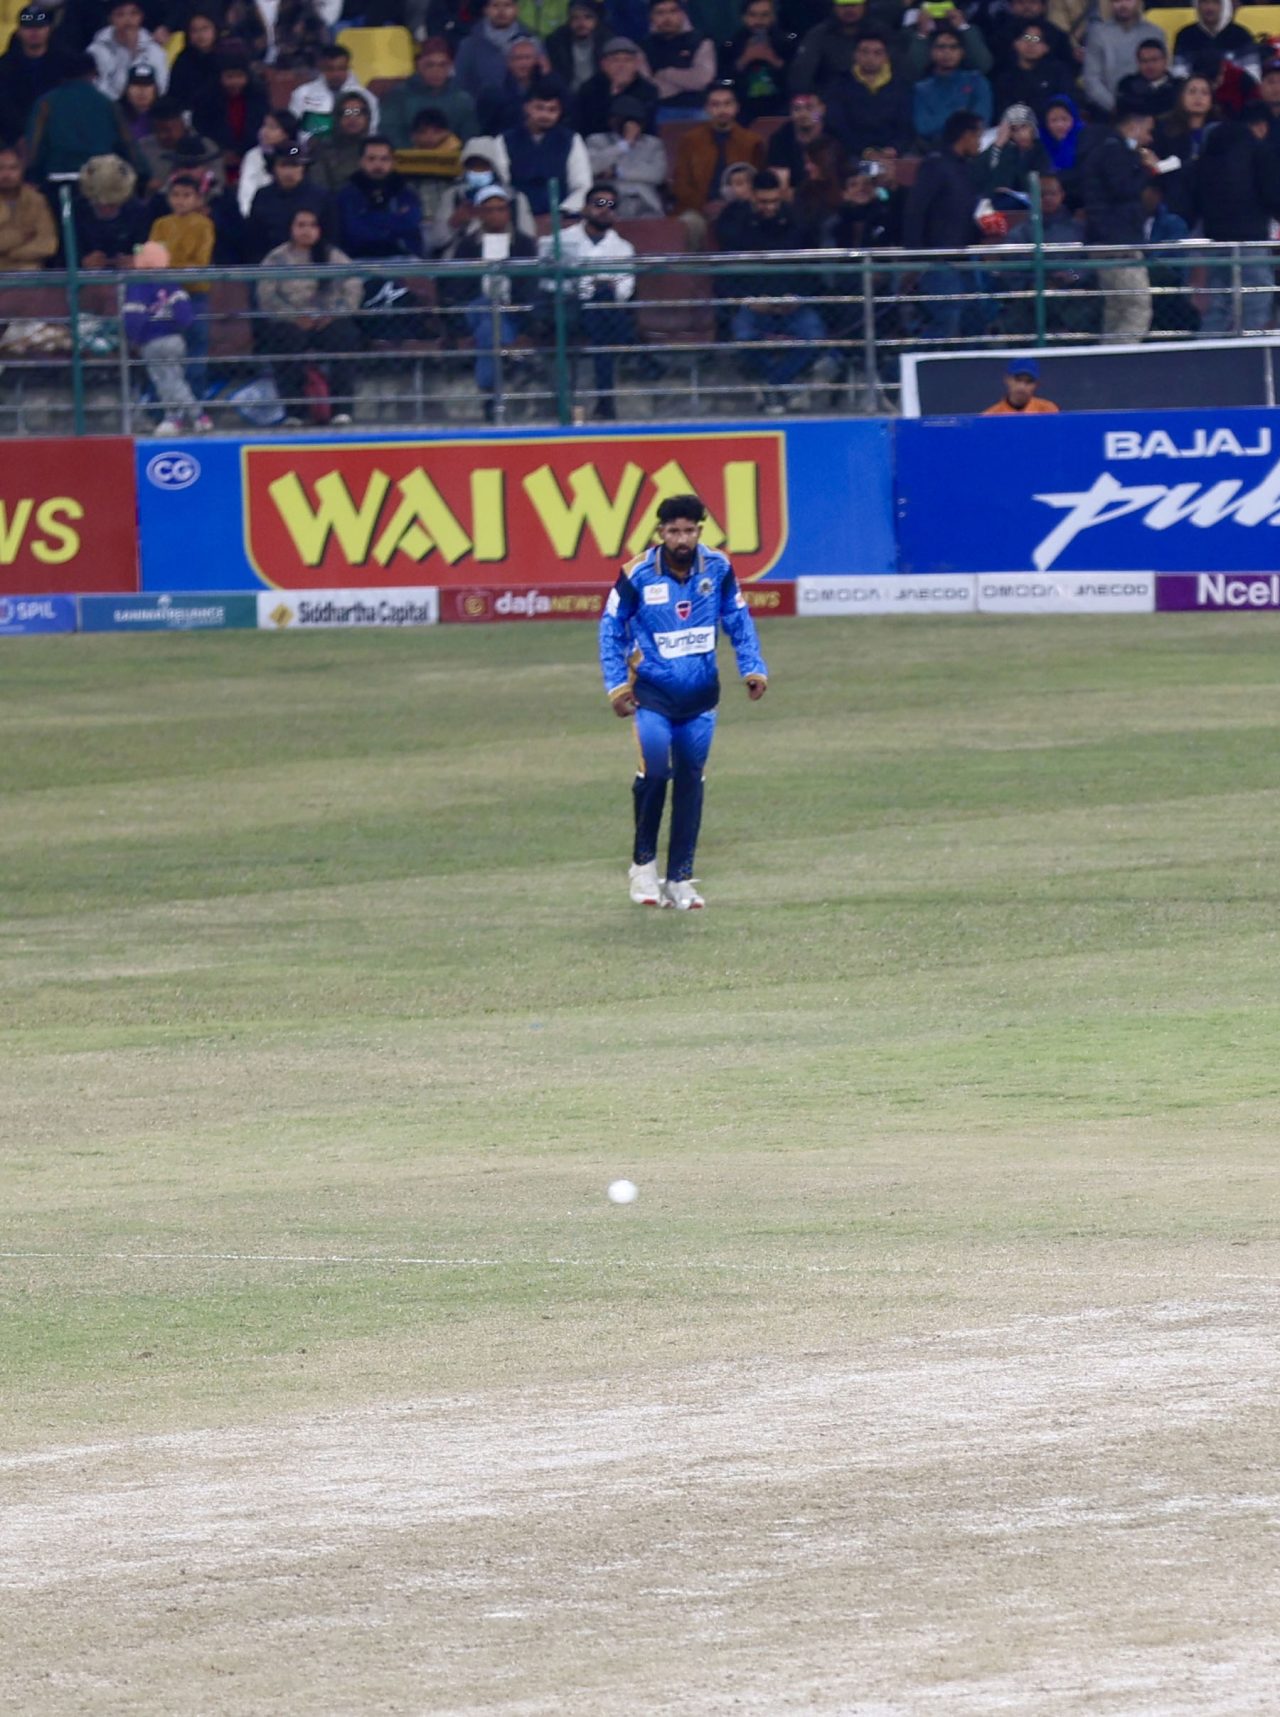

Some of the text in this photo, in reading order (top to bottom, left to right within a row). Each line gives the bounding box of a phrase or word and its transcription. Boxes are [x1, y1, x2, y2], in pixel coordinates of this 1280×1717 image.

[1105, 428, 1271, 460] BAJAJ
[268, 459, 760, 567] WAI WAI
[299, 601, 428, 625] Siddhartha Capital
